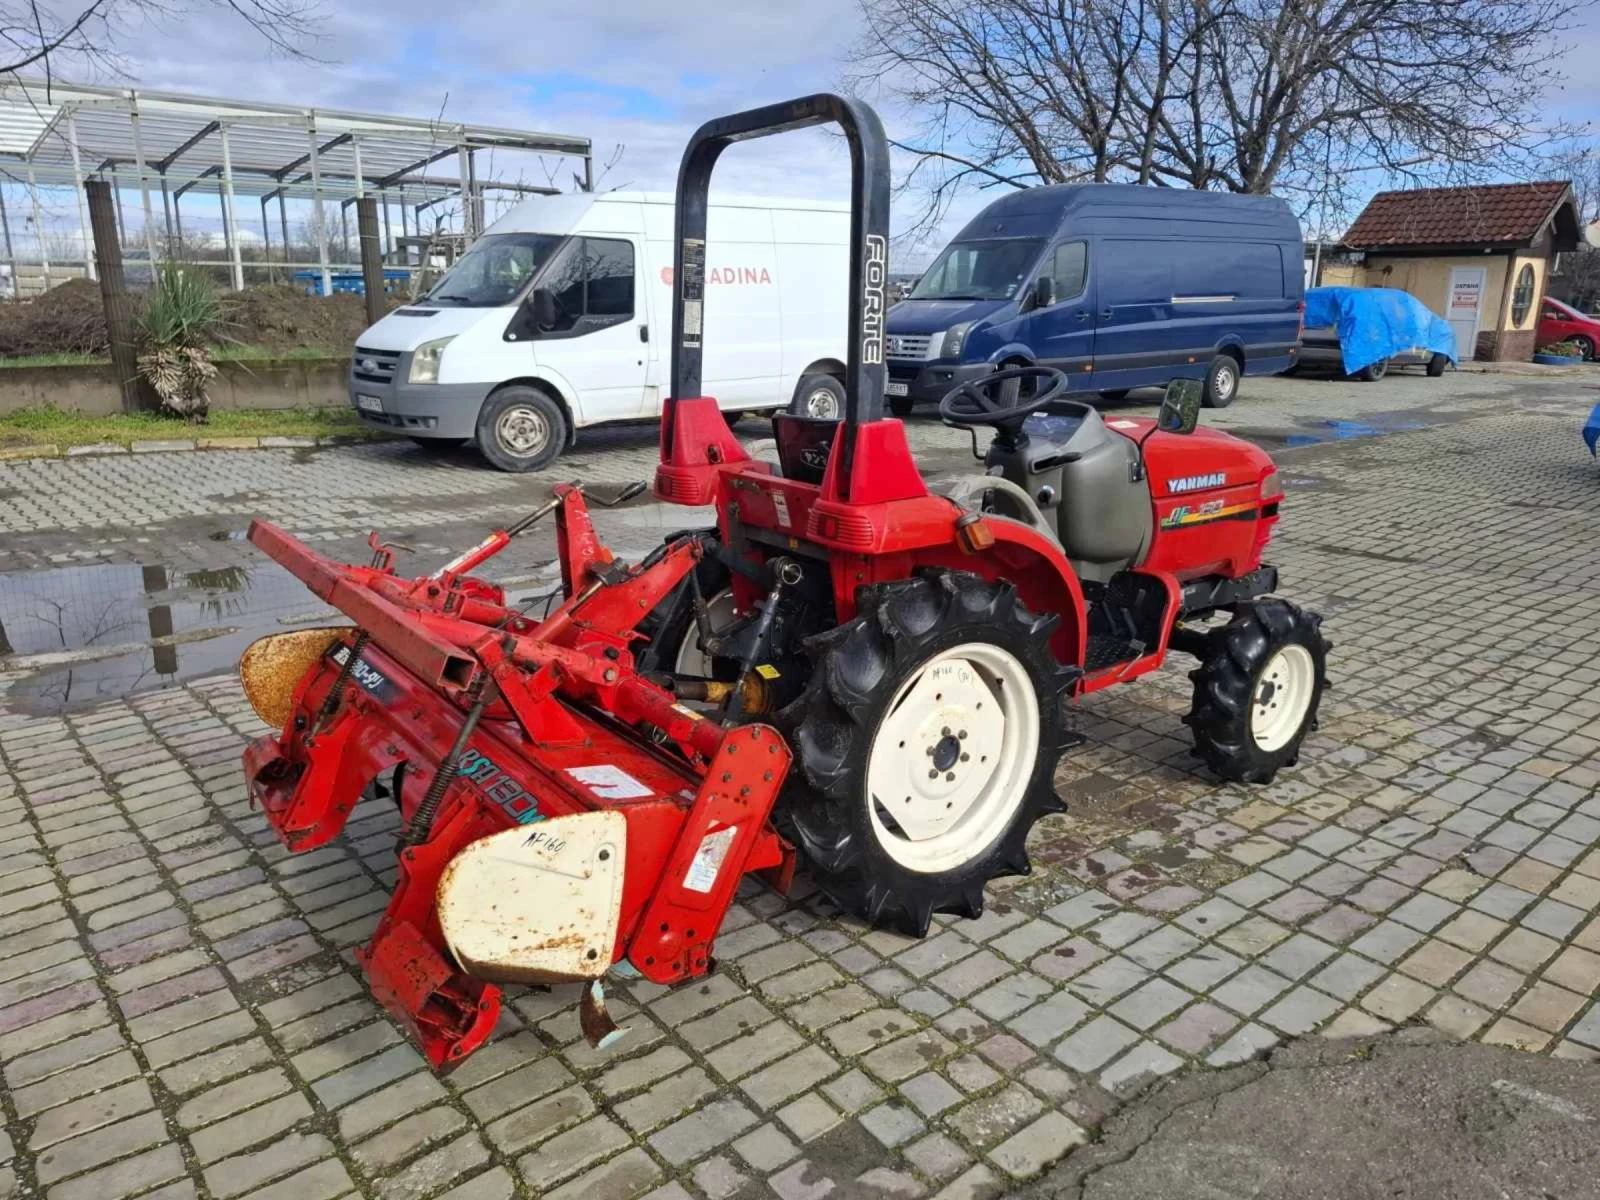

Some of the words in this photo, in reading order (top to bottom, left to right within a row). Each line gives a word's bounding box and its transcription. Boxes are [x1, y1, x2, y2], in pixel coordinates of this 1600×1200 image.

[704, 267, 772, 285] ADINA
[862, 234, 886, 365] FORTE
[1167, 472, 1226, 494] YANMAR
